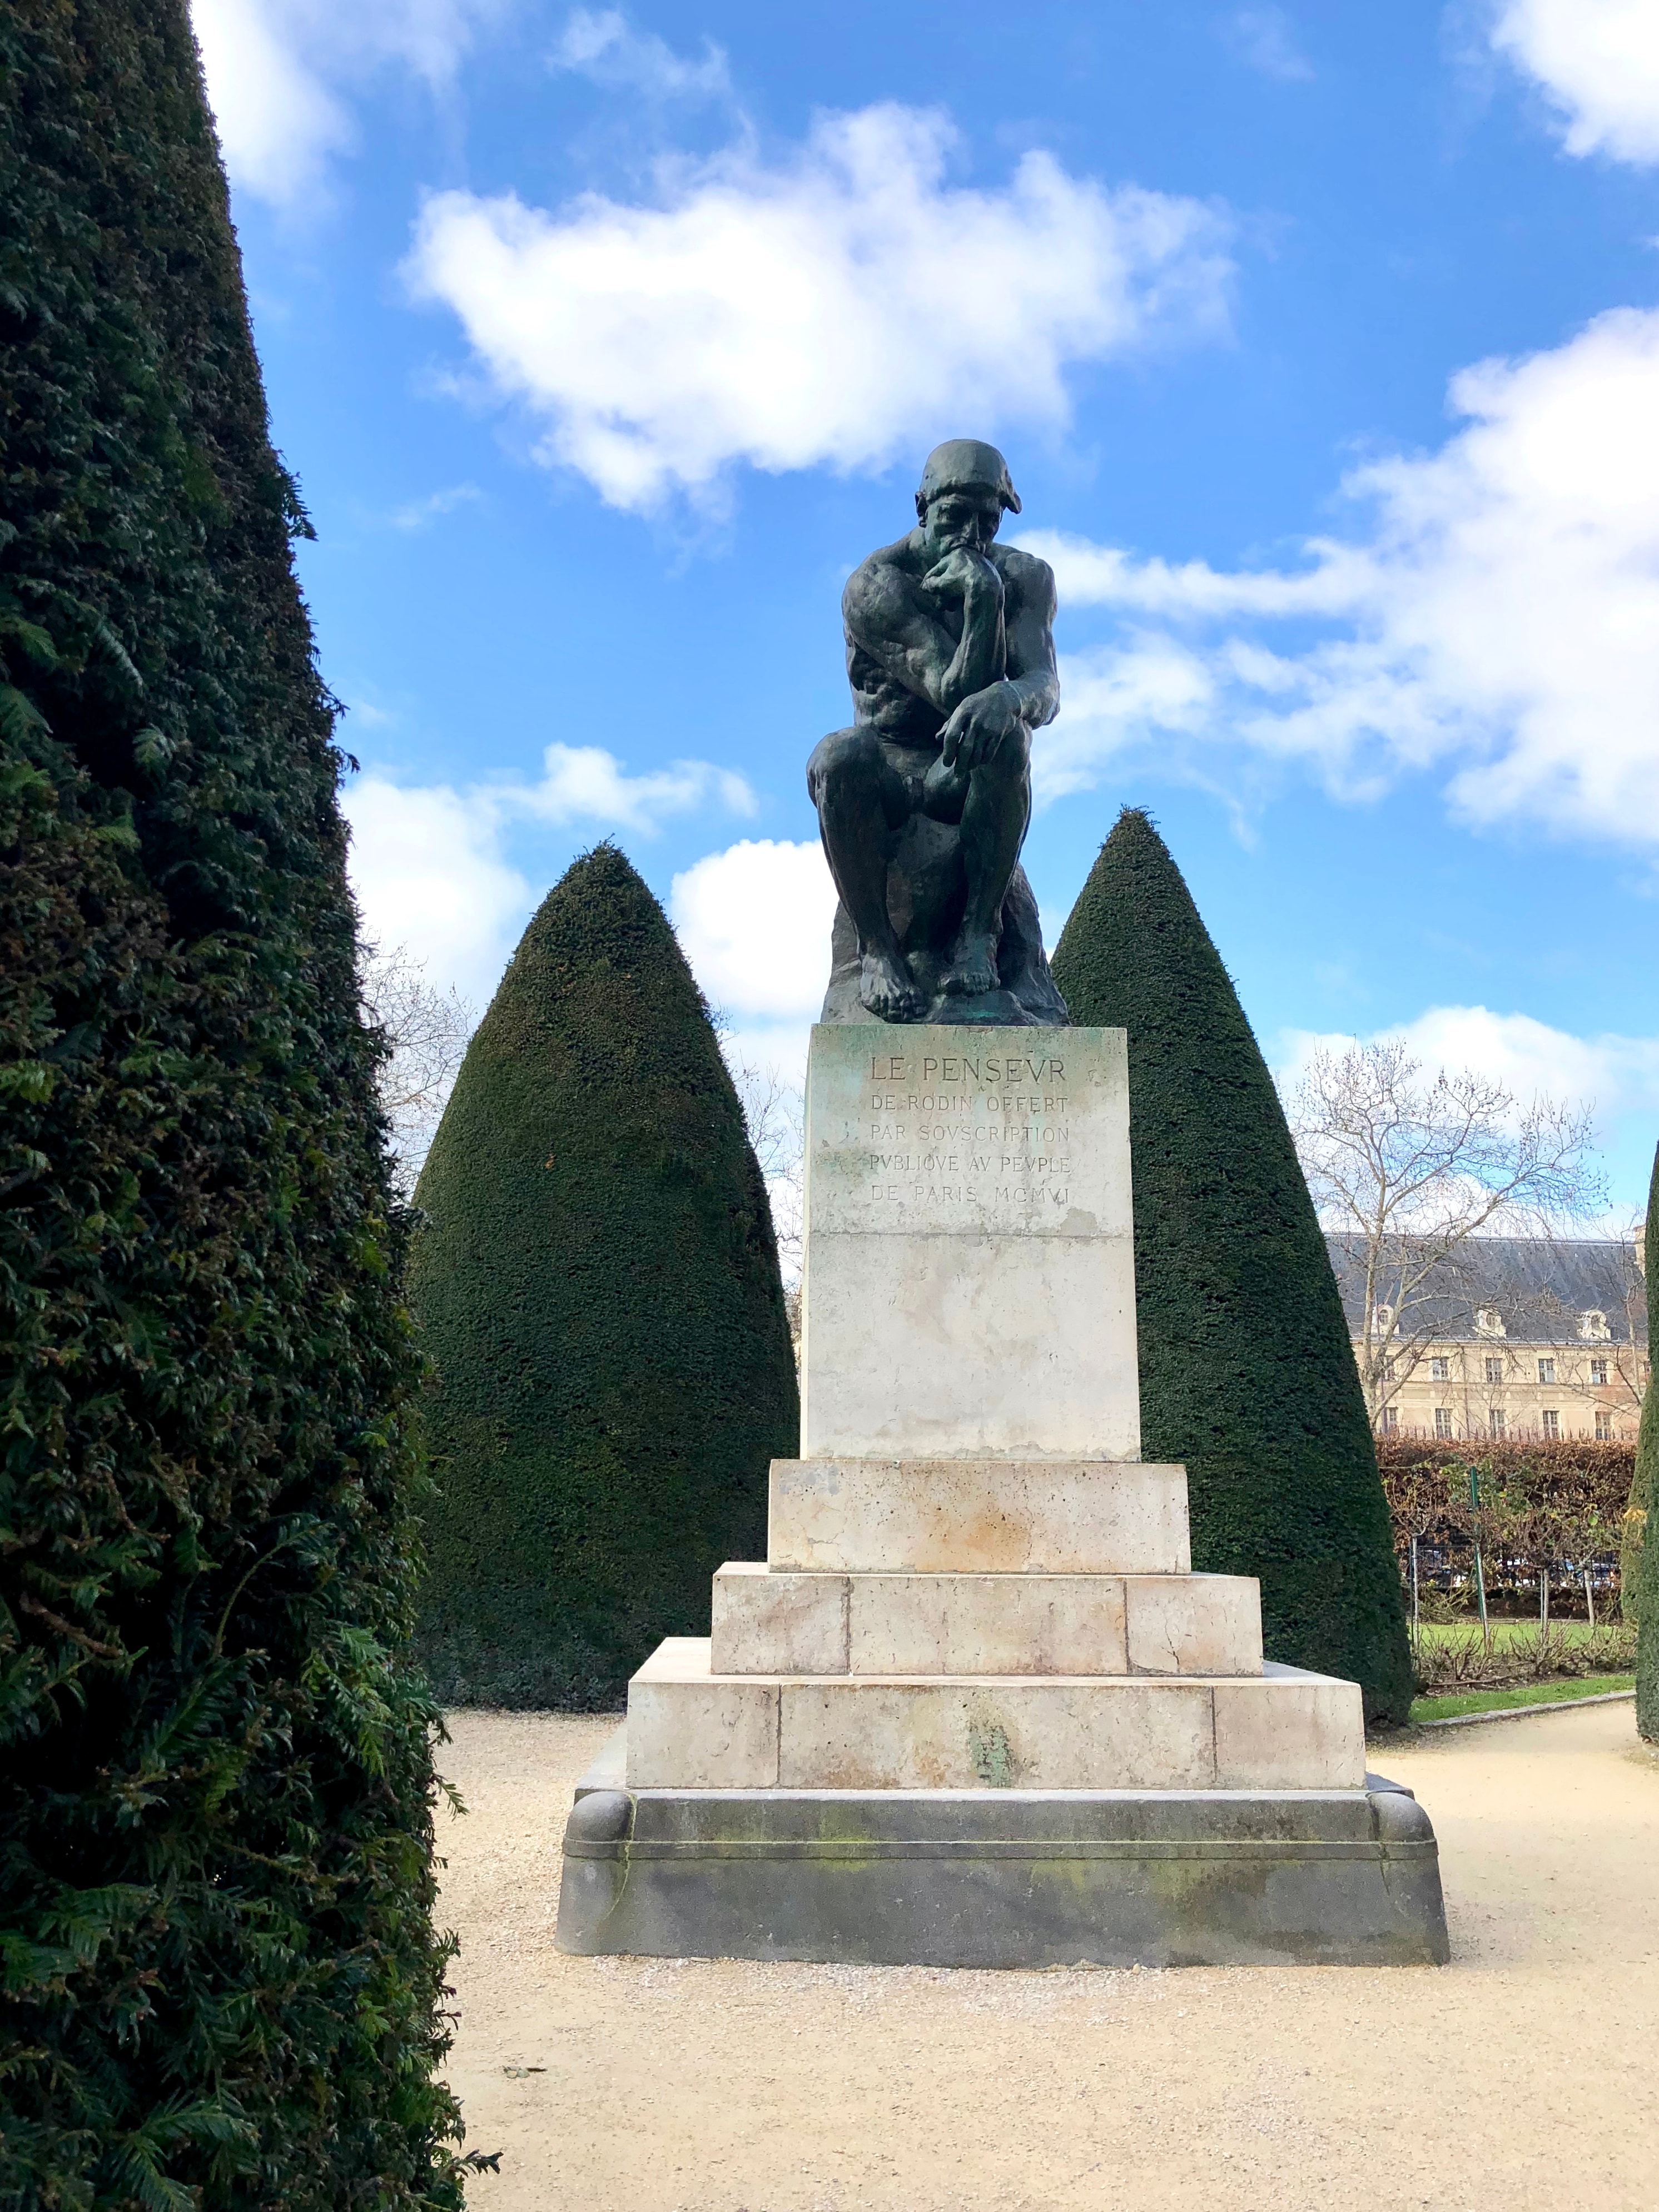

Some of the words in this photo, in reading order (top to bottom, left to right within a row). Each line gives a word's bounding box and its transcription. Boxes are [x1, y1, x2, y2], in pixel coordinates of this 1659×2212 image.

[872, 1057, 906, 1080] LE
[923, 1058, 1065, 1082] PENSEVR
[872, 1095, 895, 1110] DE
[908, 1095, 972, 1111] RODIN
[987, 1096, 1068, 1112] OFFERT
[871, 1125, 906, 1140] PAR
[920, 1125, 1069, 1142] SOVSCRIPTION
[970, 1156, 991, 1172] AV
[1001, 1156, 1070, 1172] PEVPLE
[872, 1185, 898, 1200] DE
[913, 1186, 977, 1202] PARIS
[995, 1187, 1069, 1203] MCMVI
